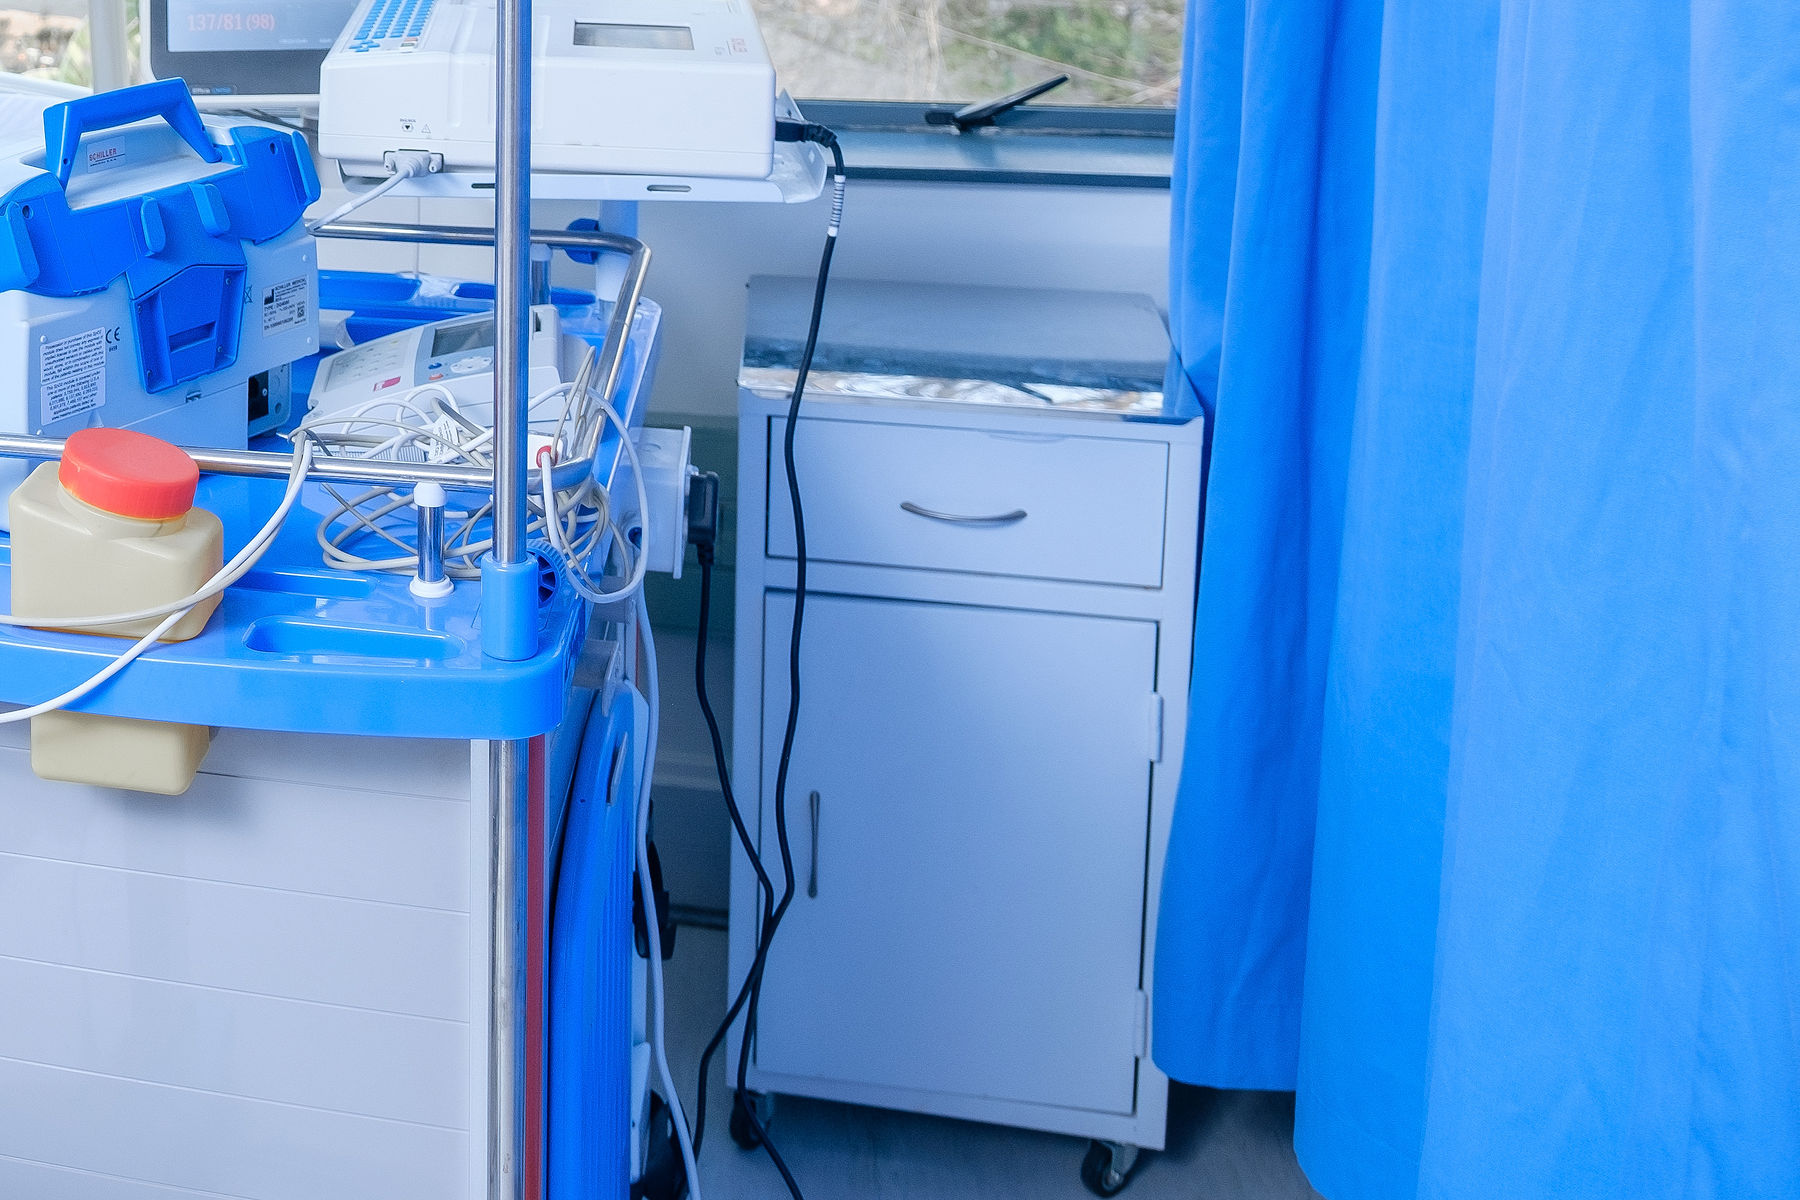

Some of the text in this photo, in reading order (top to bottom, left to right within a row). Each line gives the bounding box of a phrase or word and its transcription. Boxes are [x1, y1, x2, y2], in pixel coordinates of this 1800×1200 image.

[186, 12, 276, 32] 137/81 (98)
[89, 148, 117, 161] SCHILLER
